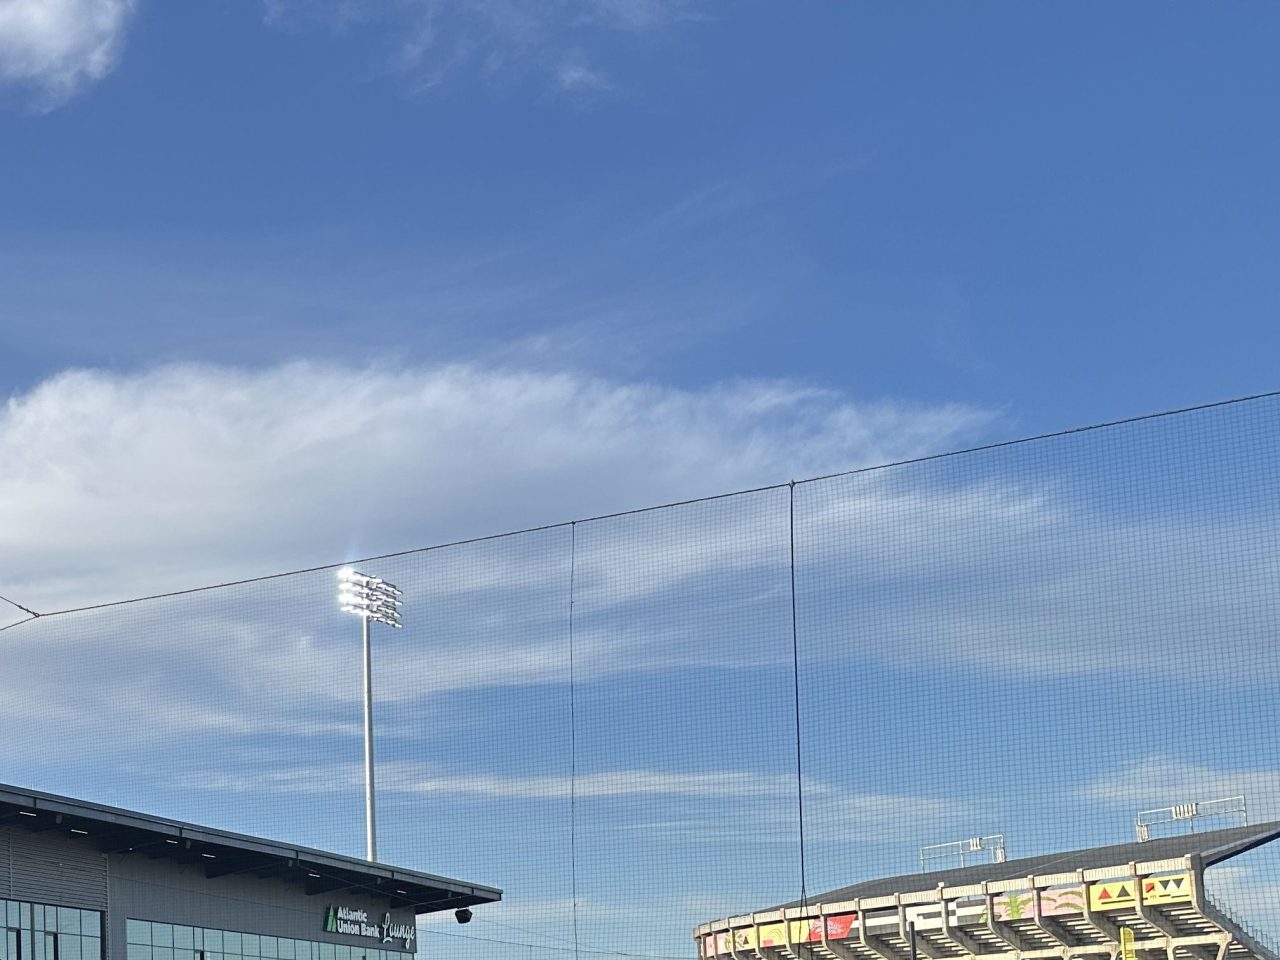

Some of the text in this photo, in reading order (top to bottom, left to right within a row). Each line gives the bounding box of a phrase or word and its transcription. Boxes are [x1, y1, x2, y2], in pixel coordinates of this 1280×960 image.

[337, 906, 368, 922] Atlantic
[337, 919, 380, 938] Union Bank
[382, 912, 415, 949] Lounge
